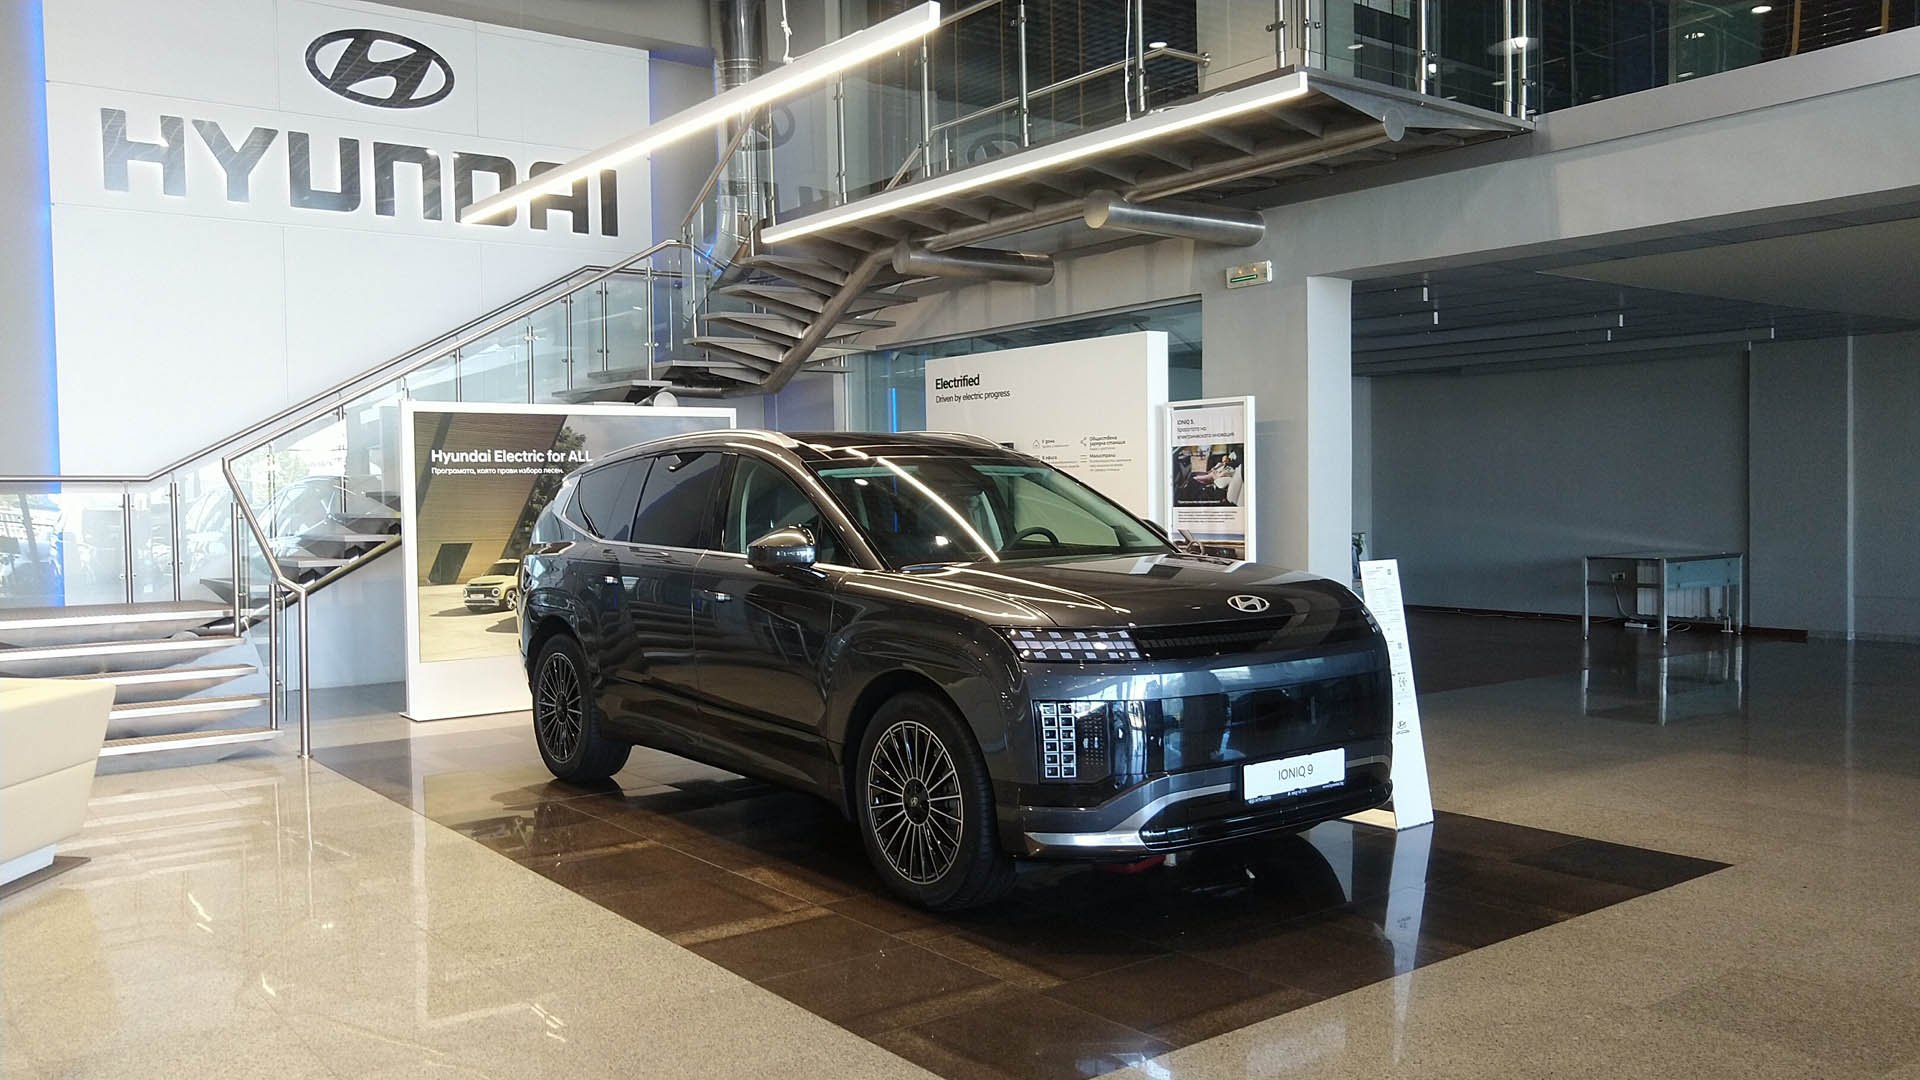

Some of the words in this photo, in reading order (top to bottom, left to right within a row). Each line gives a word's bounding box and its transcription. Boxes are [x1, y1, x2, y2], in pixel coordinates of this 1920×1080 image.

[101, 108, 618, 237] HYUNDAI
[936, 374, 980, 389] Electrified
[936, 394, 953, 403] Driven
[954, 394, 962, 403] by
[962, 392, 983, 401] electric
[984, 390, 1010, 400] progress
[431, 449, 491, 465] Hyundai
[494, 450, 545, 463] Electric
[547, 450, 567, 463] for
[568, 450, 593, 463] ALL
[431, 467, 476, 475] Програмата,
[519, 466, 543, 475] избора
[1278, 765, 1306, 781] IONIQ
[1307, 764, 1314, 775] 9
